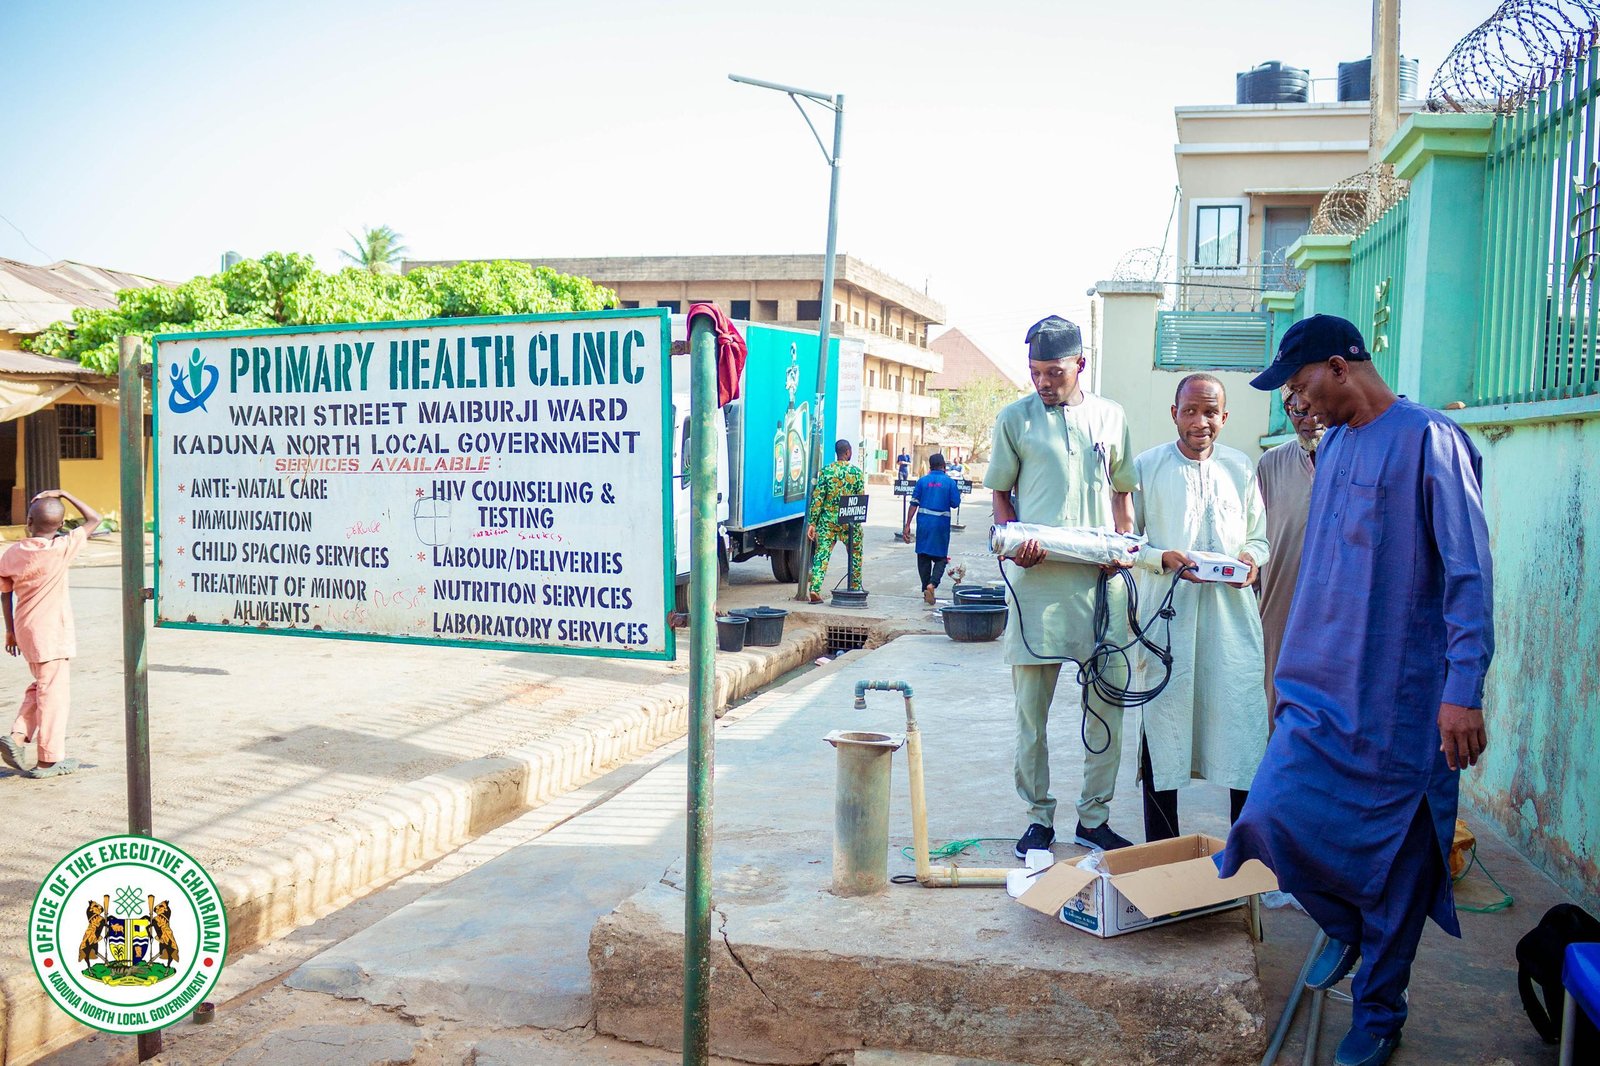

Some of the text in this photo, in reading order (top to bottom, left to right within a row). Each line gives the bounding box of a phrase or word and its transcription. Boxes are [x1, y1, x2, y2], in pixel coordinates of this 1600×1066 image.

[230, 329, 645, 393] PRIMARY HEALTH CLINIC
[229, 398, 628, 426] WARRI STREET MAIBURJI WARD
[173, 431, 640, 455] KADUNA NORTH LOCAL GOVERNMENT
[275, 458, 360, 472] SERVICES
[370, 456, 491, 471] AVAILABLE
[191, 478, 328, 500] ANTE-NATAL CARE
[432, 480, 616, 505] HIV COUNSELING &
[848, 496, 858, 506] NO
[192, 509, 312, 533] IMMUNISATION
[477, 506, 555, 529] TESTING
[839, 505, 866, 517] PARKING
[191, 541, 390, 569] CHILD SPACING SERVICES
[433, 546, 623, 575] LABOUR/DELIVERIES
[191, 572, 279, 596] TREATMENT
[284, 576, 306, 598] OF
[310, 577, 367, 602] MINOR
[433, 579, 537, 605] NUTRITION
[542, 584, 633, 610] SERVICES
[433, 612, 649, 645] LABORATORY SERVICES
